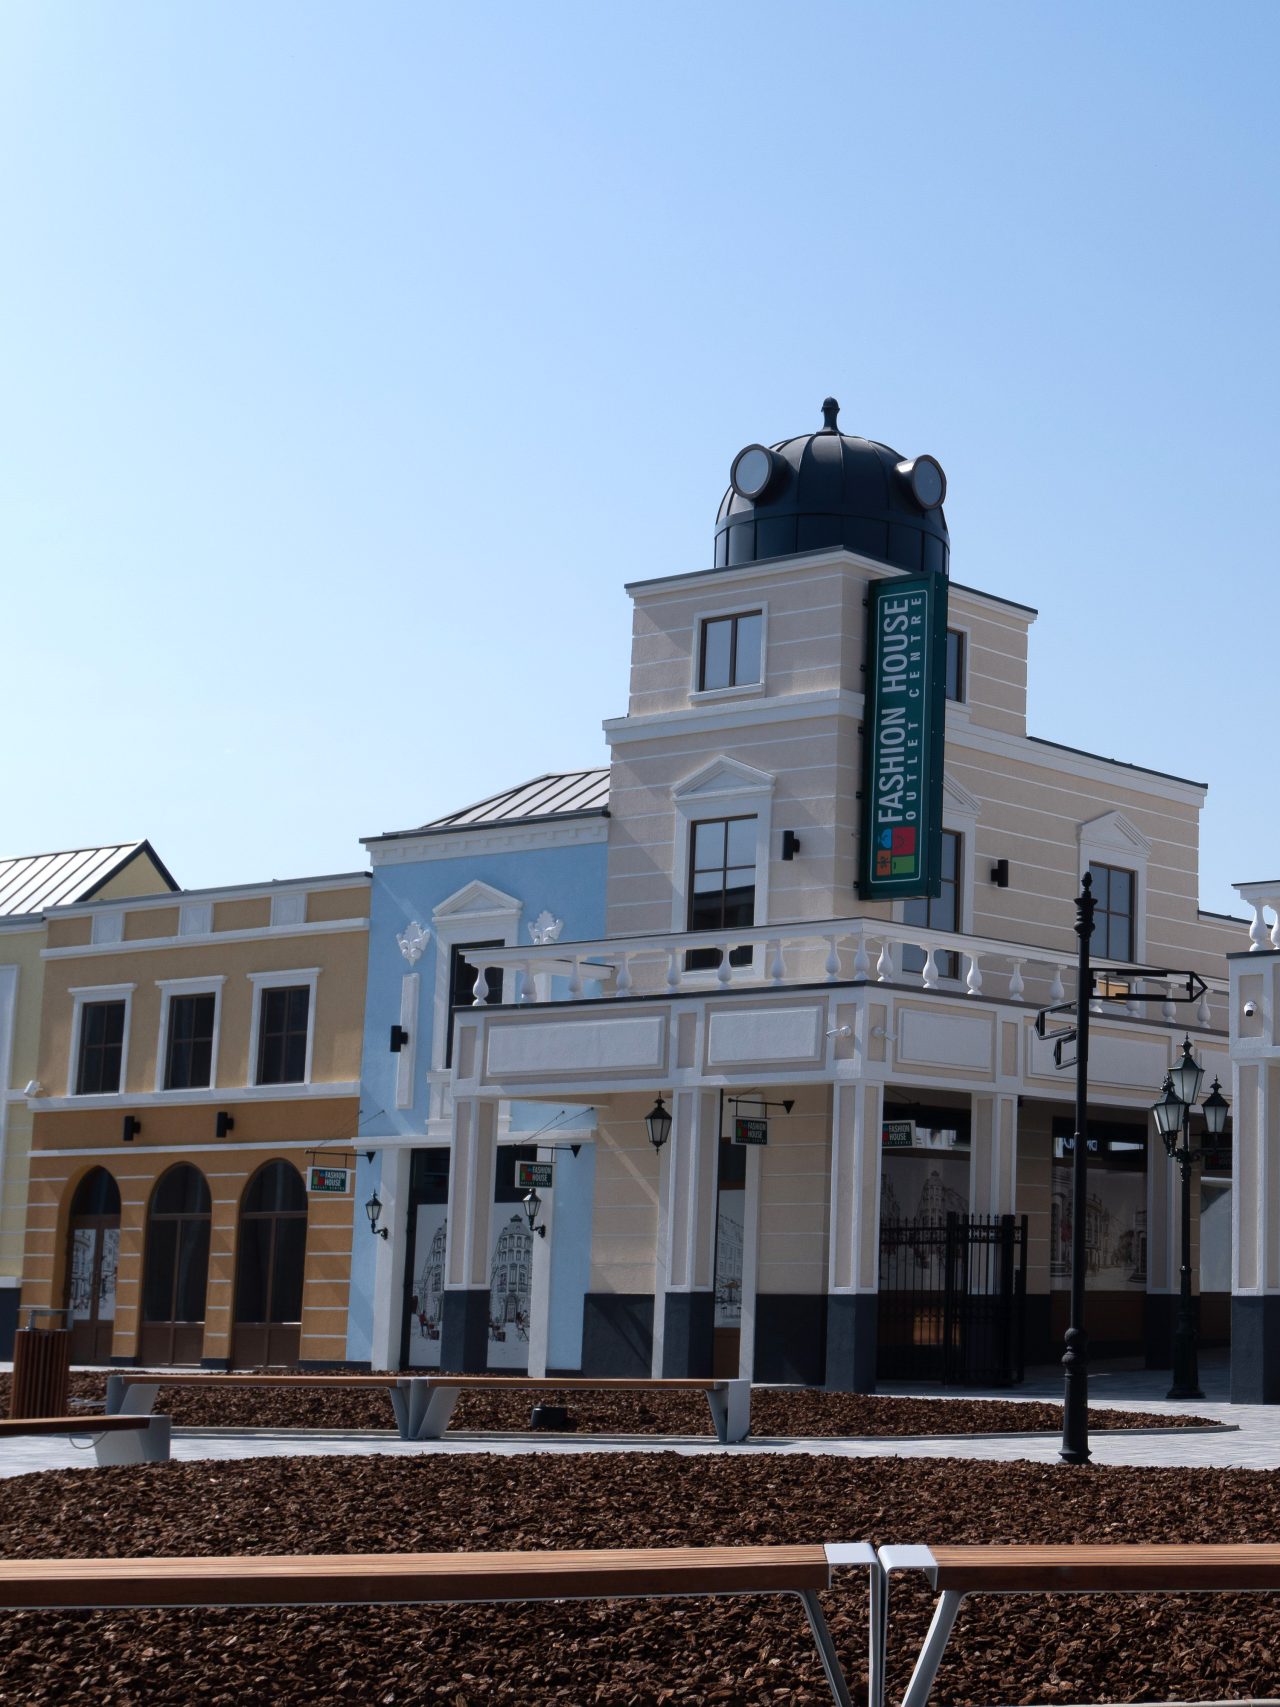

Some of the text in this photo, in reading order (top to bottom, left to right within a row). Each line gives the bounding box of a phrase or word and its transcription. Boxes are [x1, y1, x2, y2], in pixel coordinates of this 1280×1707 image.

[878, 599, 909, 823] FASHION HOUSE
[905, 597, 922, 820] OUTLET CENTRE
[748, 1121, 766, 1130] FASHION
[889, 1123, 910, 1133] FASHION
[748, 1129, 762, 1138] HOUSE
[889, 1132, 907, 1141] HOUSE
[532, 1165, 552, 1174] FASHION
[325, 1170, 346, 1180] FASHION
[532, 1173, 547, 1182] HOUSE
[325, 1178, 341, 1187] HOUSE
